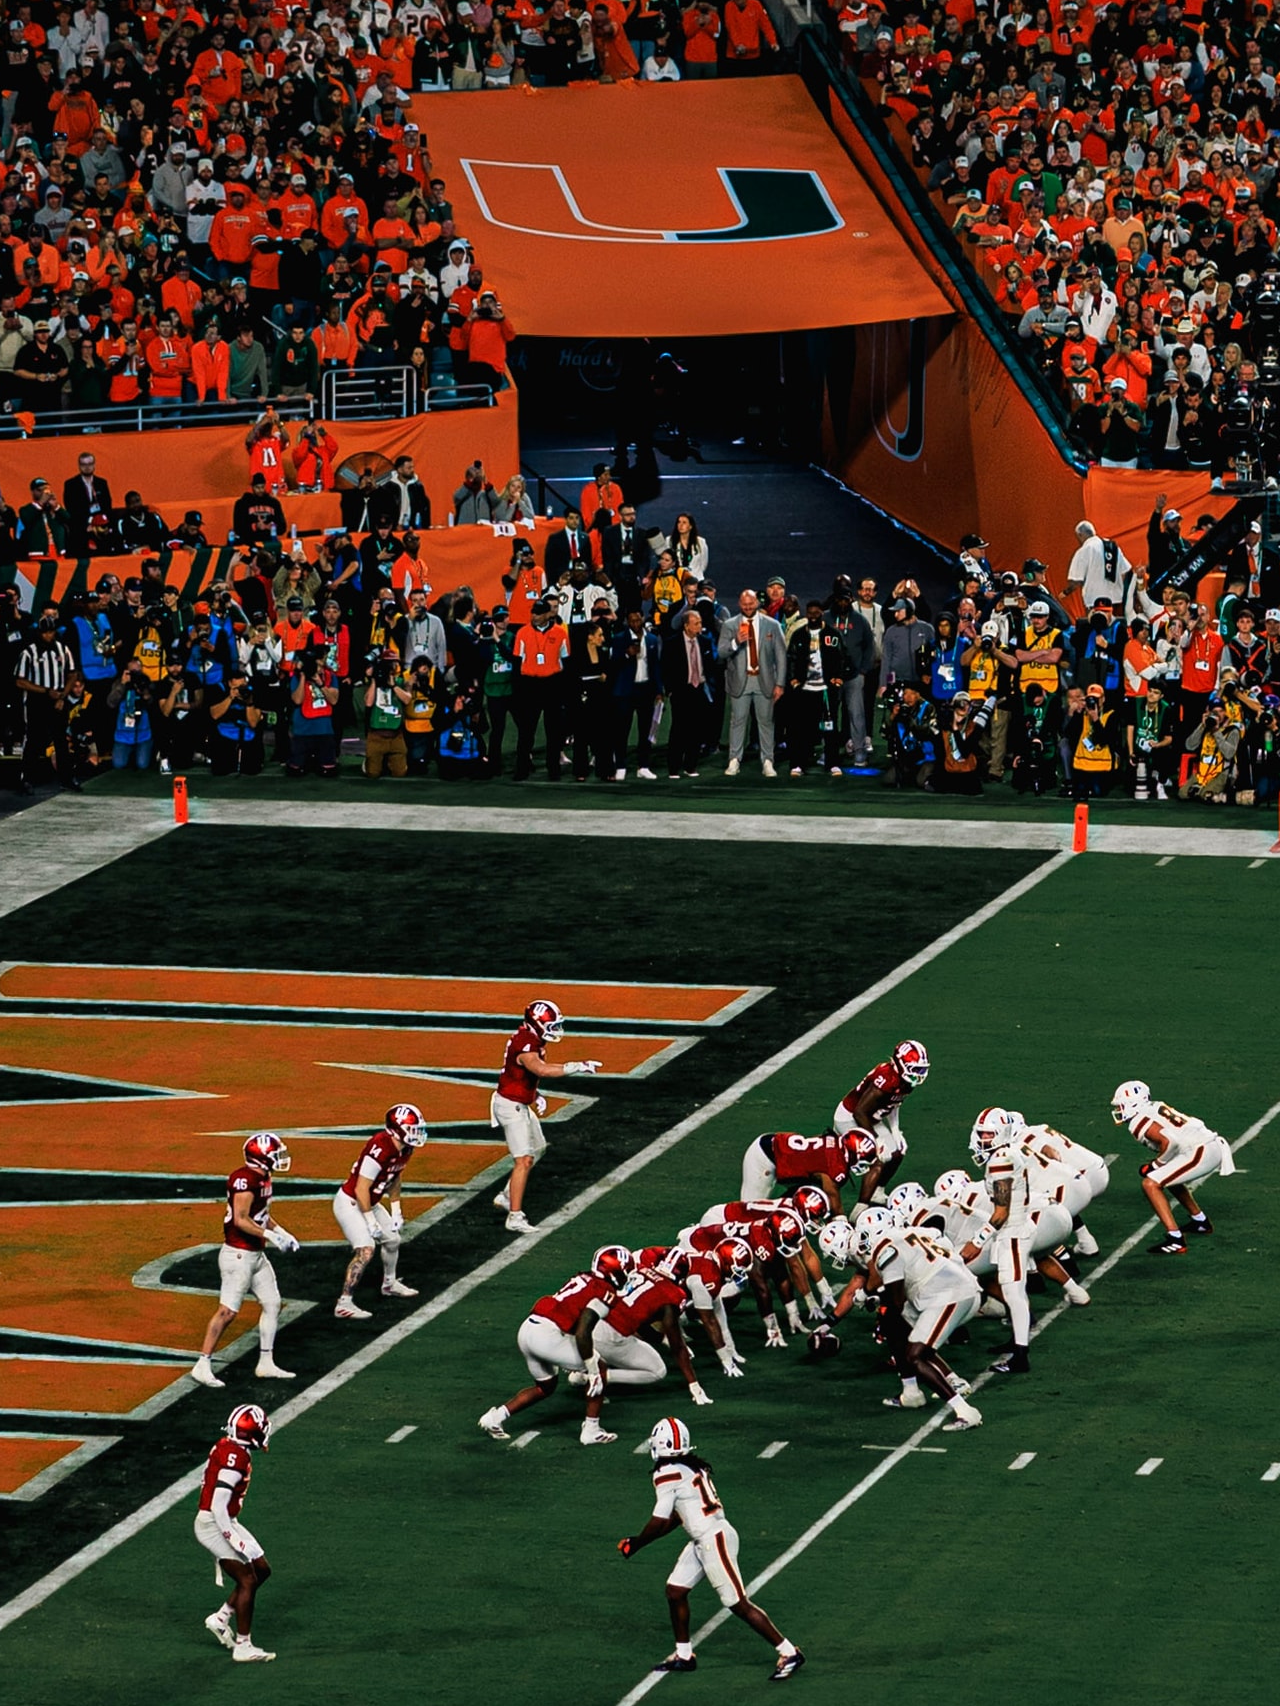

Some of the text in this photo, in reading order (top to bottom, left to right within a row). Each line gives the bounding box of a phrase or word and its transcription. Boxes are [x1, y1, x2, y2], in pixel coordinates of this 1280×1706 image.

[406, 153, 414, 172] 1
[874, 1075, 887, 1088] 21
[234, 1177, 249, 1190] 46
[755, 1246, 771, 1261] 95
[227, 1453, 238, 1467] 5
